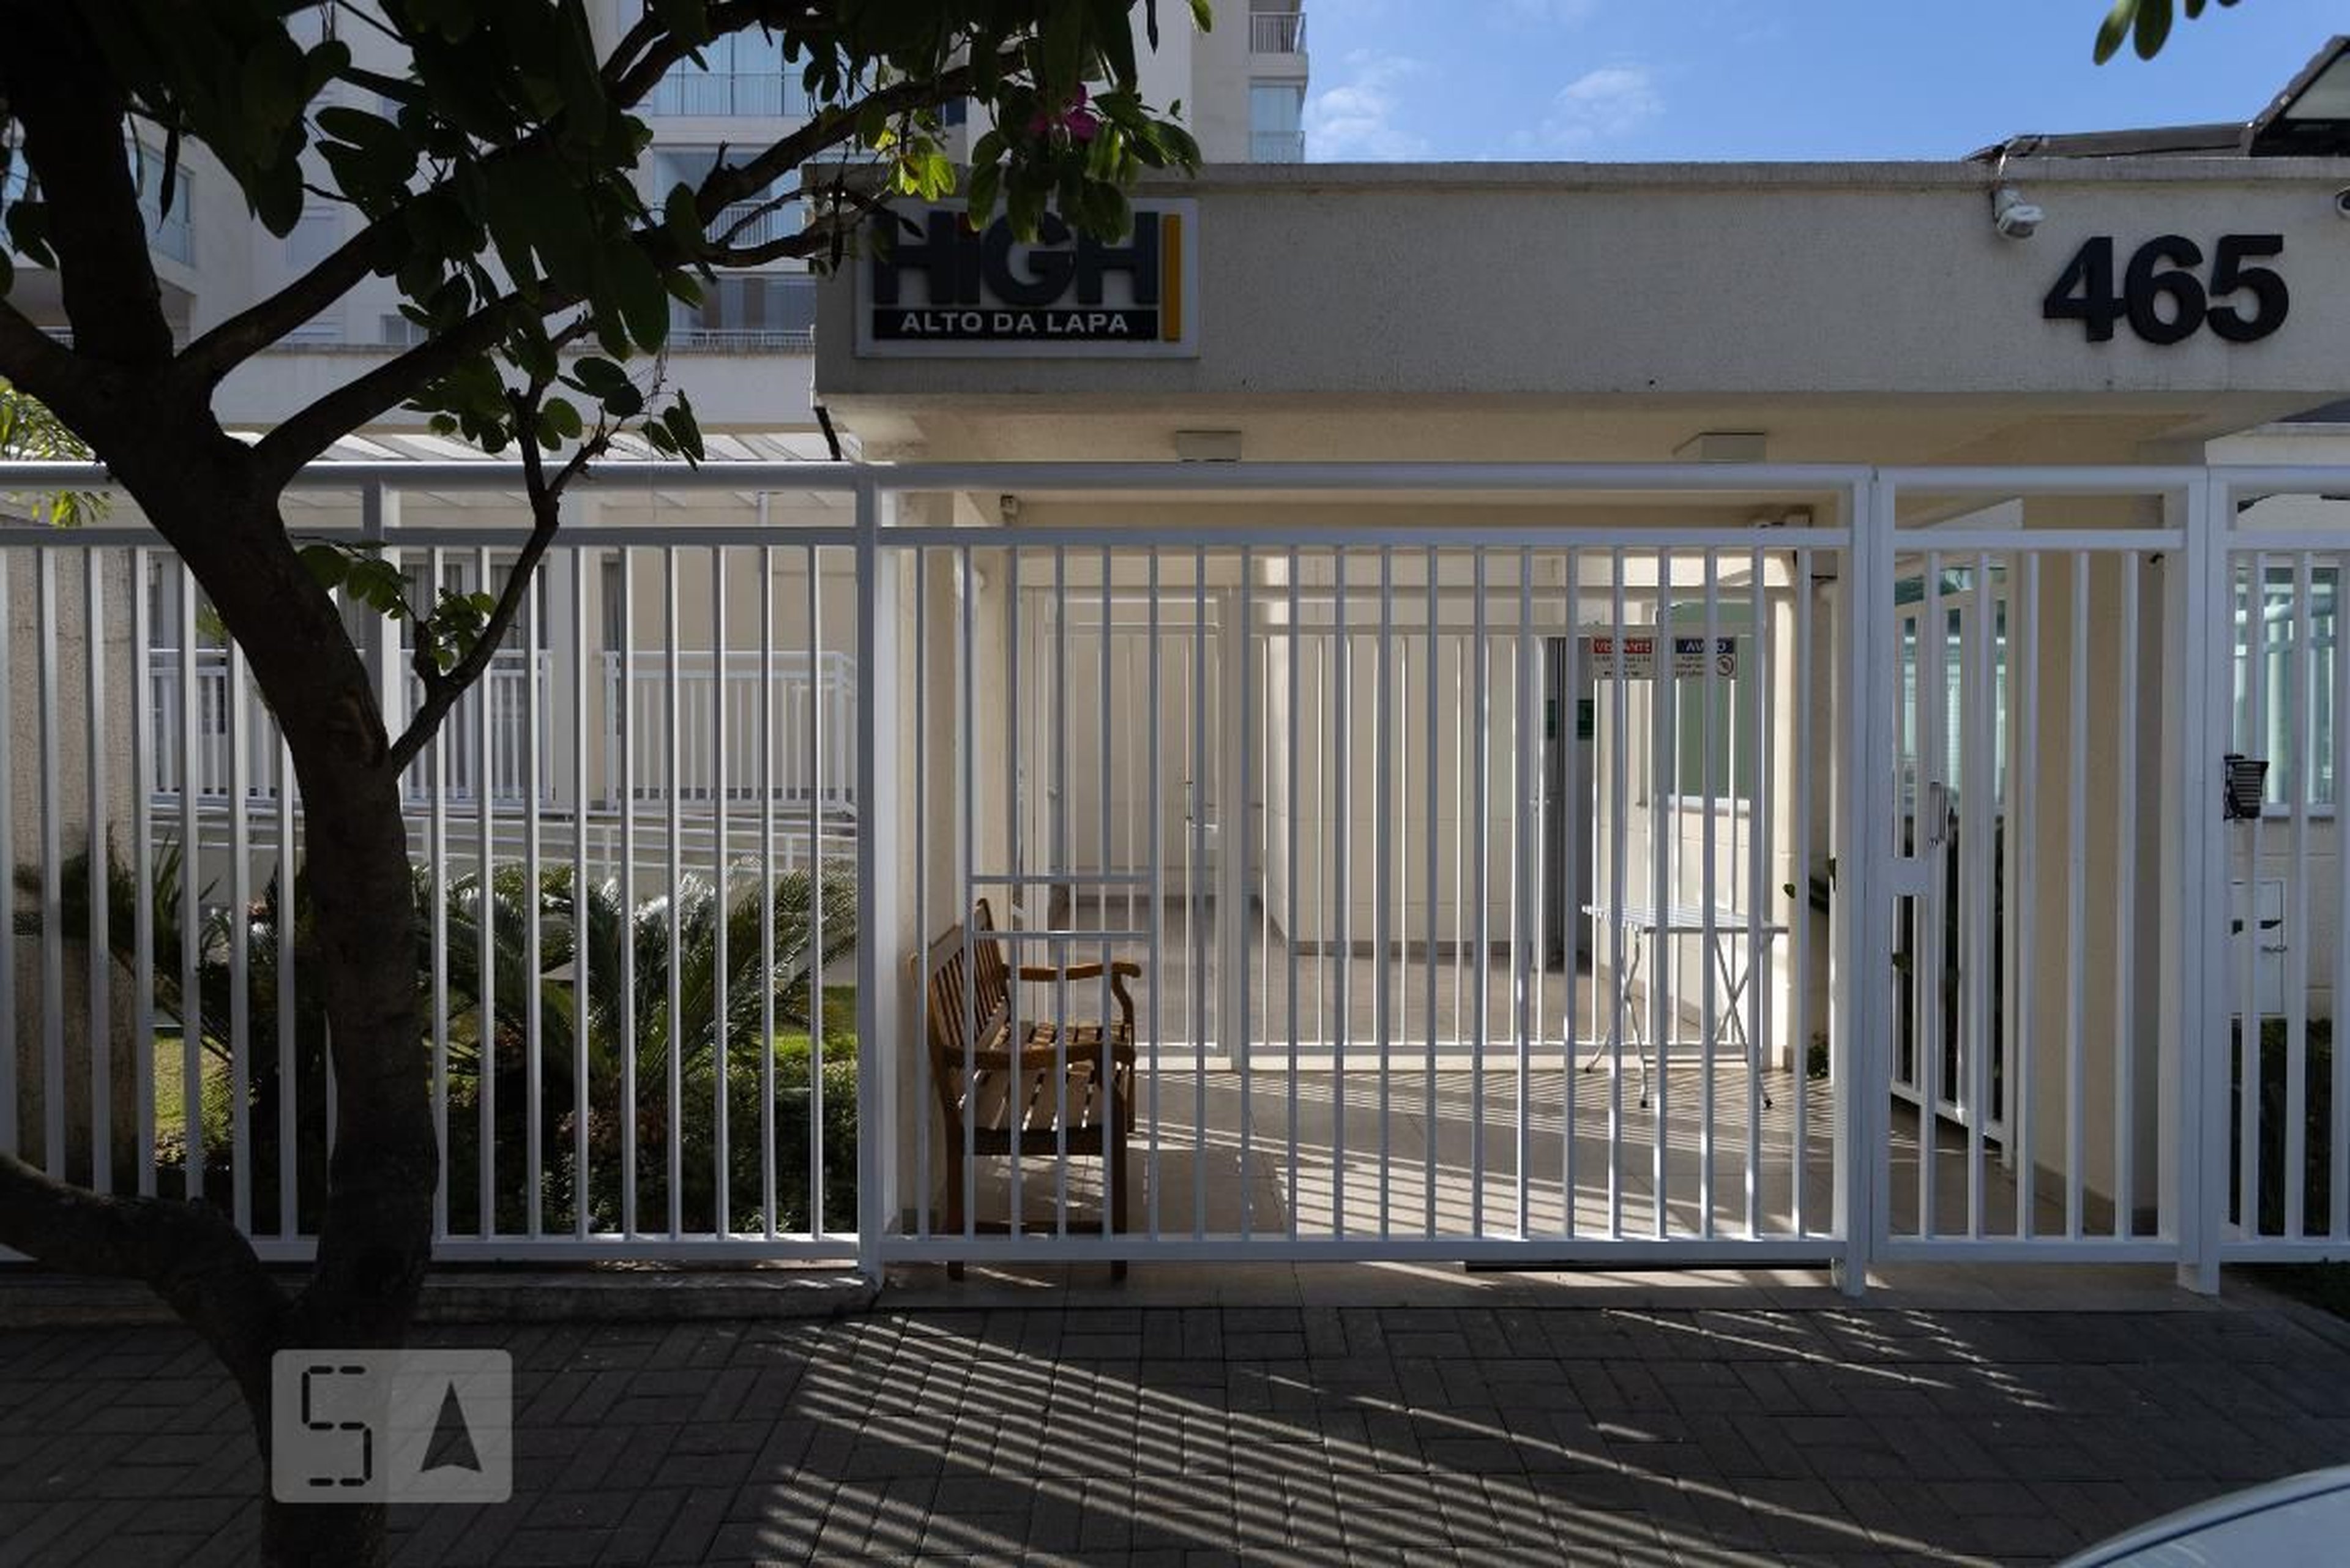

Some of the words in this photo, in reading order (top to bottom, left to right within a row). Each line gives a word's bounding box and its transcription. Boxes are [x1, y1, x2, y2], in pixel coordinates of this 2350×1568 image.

[873, 211, 1159, 305] HIGH
[2042, 234, 2289, 345] 465
[900, 312, 983, 333] ALTO
[993, 313, 1037, 332] DA
[1047, 313, 1129, 333] LAPA
[1685, 641, 1726, 652] AVO
